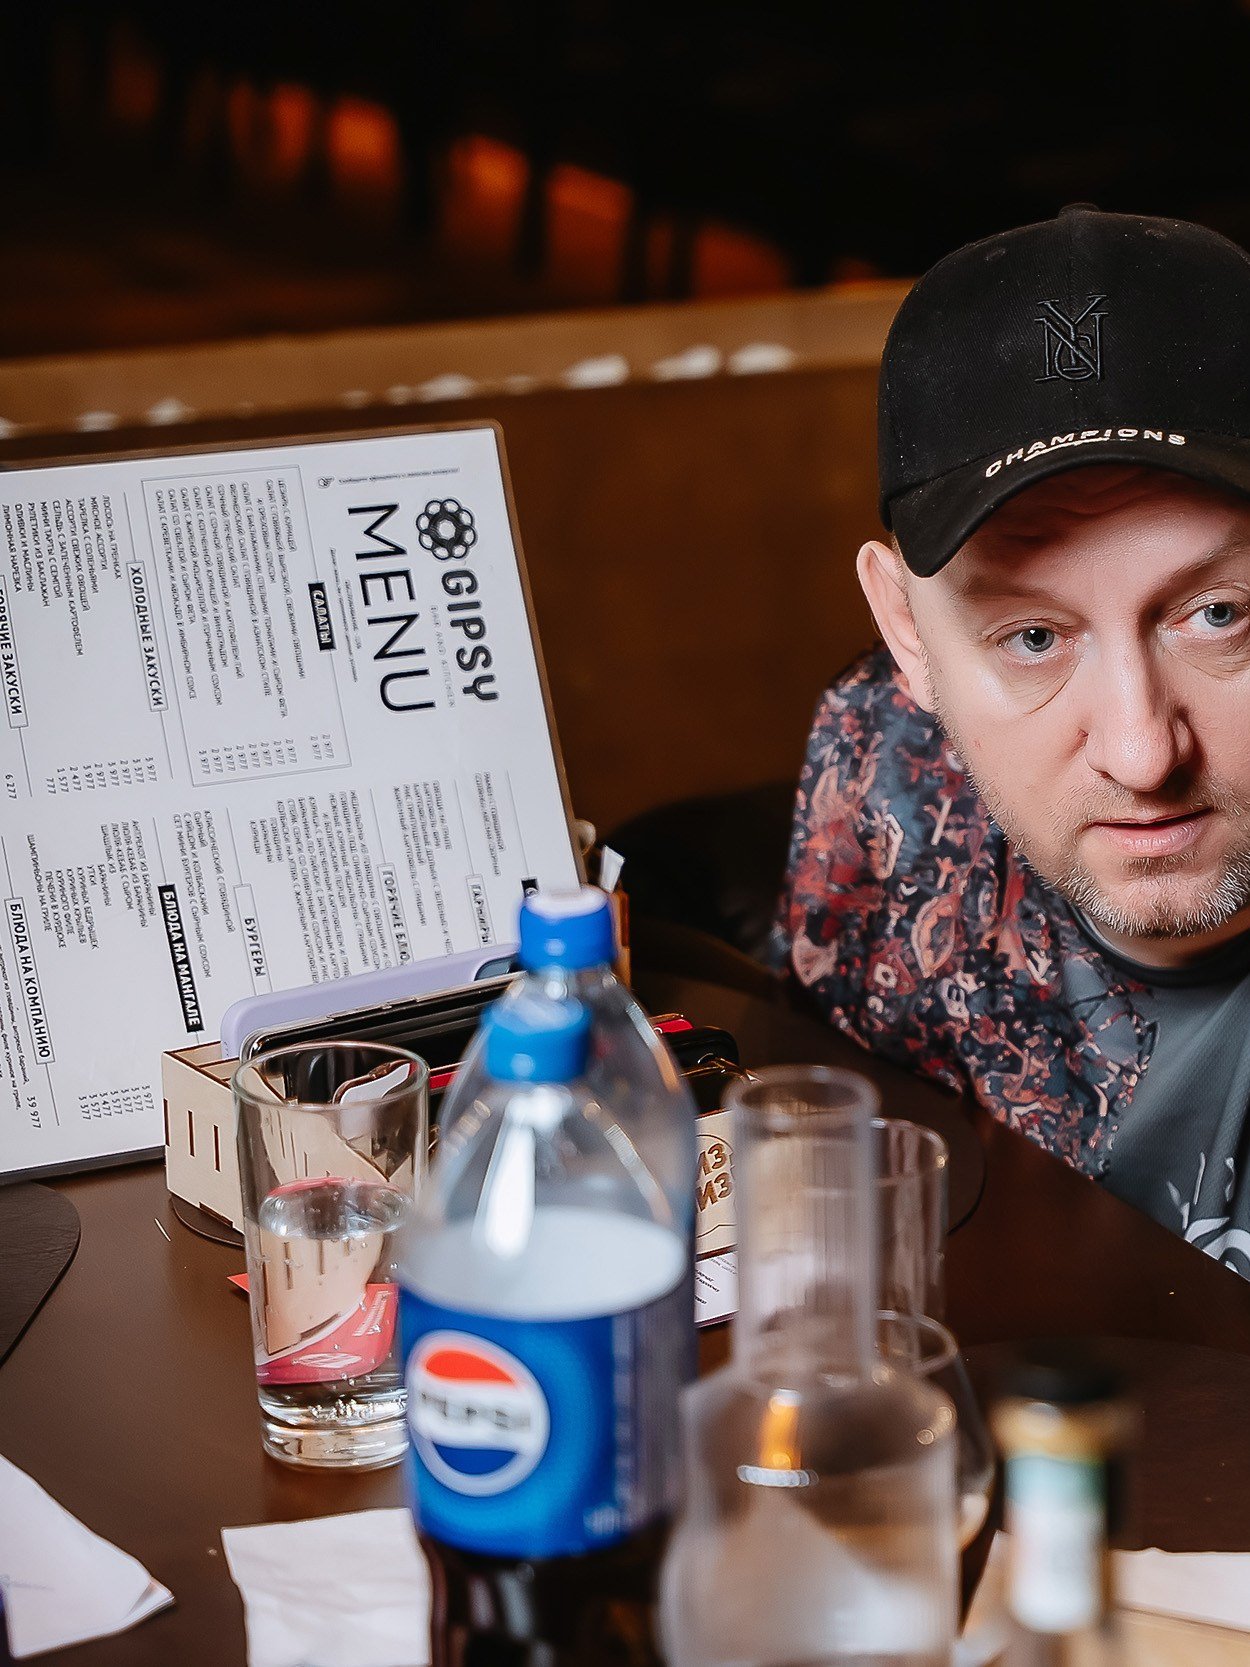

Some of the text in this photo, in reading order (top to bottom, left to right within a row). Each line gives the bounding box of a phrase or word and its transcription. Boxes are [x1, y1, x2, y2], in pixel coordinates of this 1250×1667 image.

[985, 428, 1186, 478] CHAMPIONS
[129, 566, 163, 706] ХОЛОДНЫЕ ЗАКУСКИ
[312, 590, 332, 642] САЛАТЫ
[347, 502, 434, 713] MENU
[441, 568, 497, 702] GIPSY
[2, 653, 22, 714] ЗАКУСКИ
[7, 903, 50, 1058] БЛЮДА НА КОМПАНИЮ
[162, 891, 199, 1024] БЛЮДА НА МАНГАЛЕ
[244, 918, 265, 976] БУРГЕРЫ
[394, 932, 410, 962] БЛЮ
